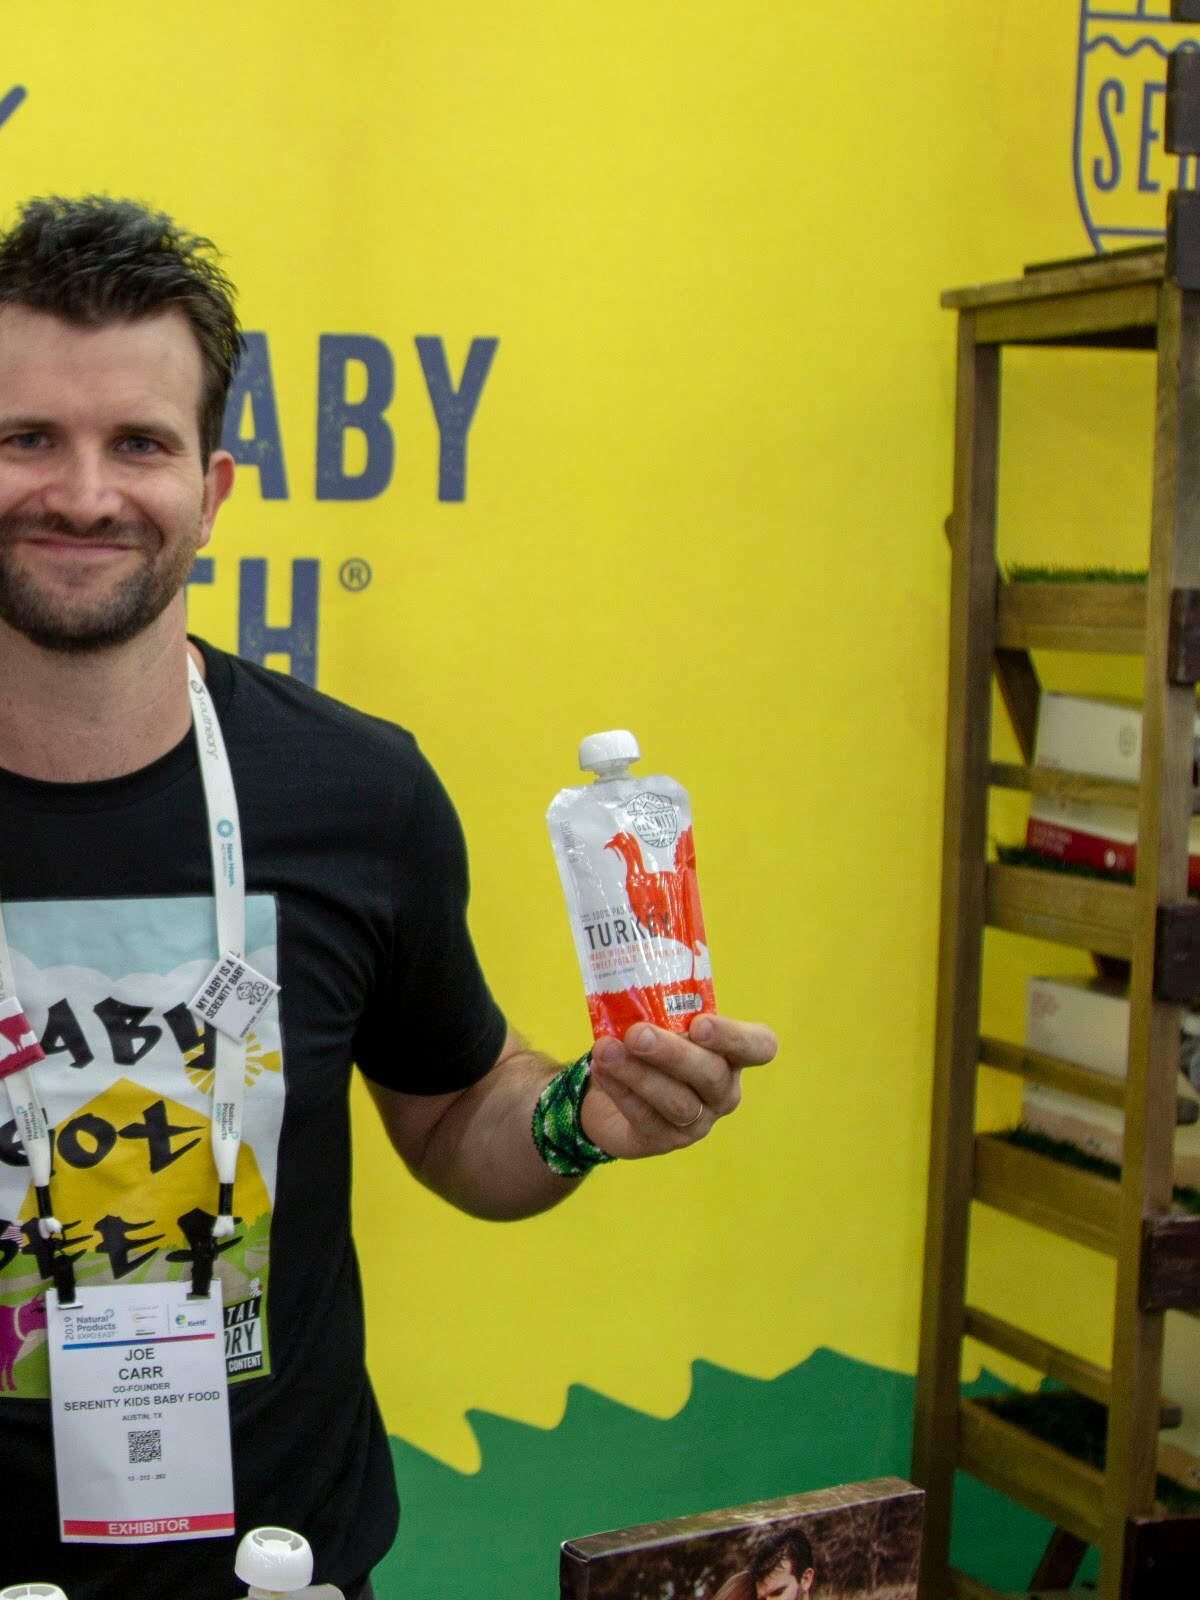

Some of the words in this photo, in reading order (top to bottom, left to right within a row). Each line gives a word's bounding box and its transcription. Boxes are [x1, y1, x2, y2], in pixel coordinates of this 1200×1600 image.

[223, 330, 501, 504] ABY
[197, 699, 218, 760] youtheory
[584, 912, 670, 949] TURKEY
[196, 996, 209, 1011] MY
[205, 975, 224, 998] BABY
[219, 966, 231, 977] IS
[206, 984, 232, 1019] SERENITY
[229, 964, 245, 985] BABY
[76, 1313, 109, 1324] Natural
[76, 1322, 116, 1332] Products
[64, 1316, 75, 1341] 2019
[125, 1348, 155, 1361] JOE
[228, 1355, 261, 1372] CONTENT
[118, 1366, 163, 1381] CARR
[112, 1382, 171, 1393] CO-FOUNDER
[64, 1399, 121, 1411] SERENITY
[124, 1396, 150, 1408] KIDS
[153, 1393, 186, 1405] BABY
[188, 1391, 220, 1402] FOOD
[122, 1413, 152, 1422] AUSTIN,
[153, 1412, 162, 1420] TX
[108, 1519, 190, 1535] EXHIBITOR
